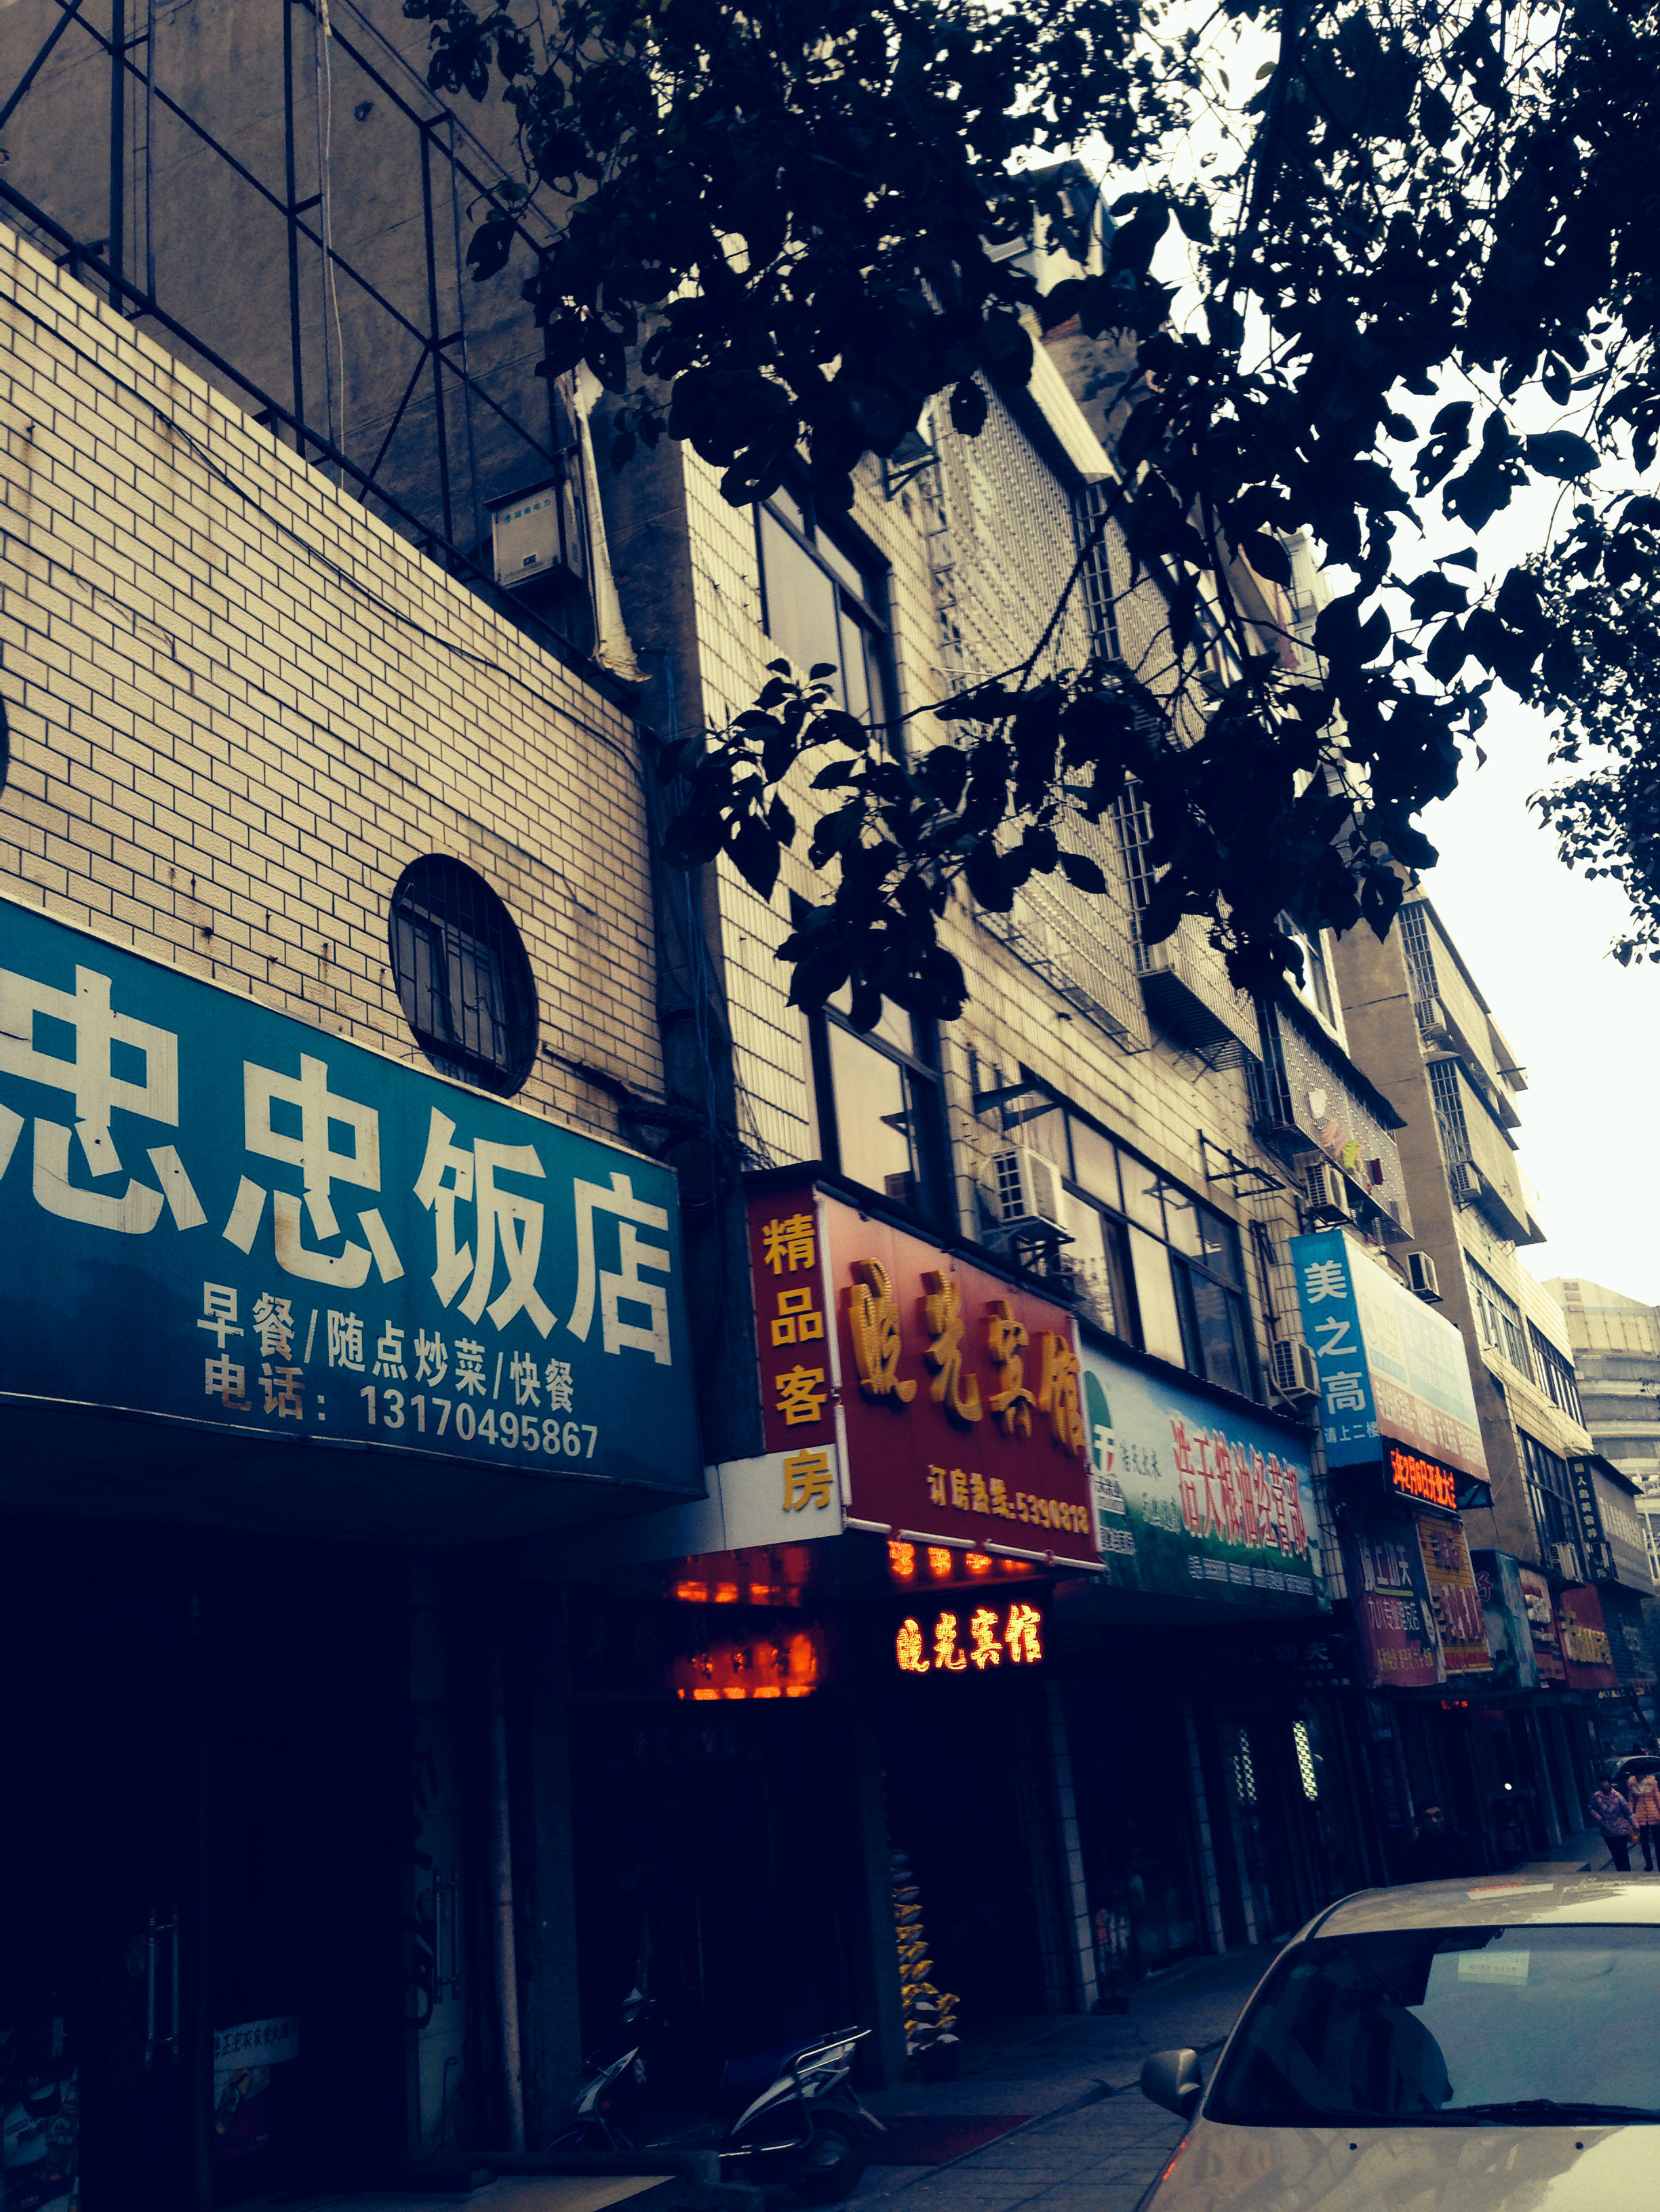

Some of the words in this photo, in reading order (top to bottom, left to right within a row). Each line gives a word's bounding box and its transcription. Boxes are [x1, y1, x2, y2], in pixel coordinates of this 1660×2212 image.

[0, 963, 672, 1366] 忠忠饭店
[197, 1282, 575, 1414] 早餐/随点炒菜/快餐
[763, 1215, 835, 1512] 精品客房
[1304, 1260, 1366, 1415] 美之高
[1324, 1420, 1379, 1445] 请上二楼
